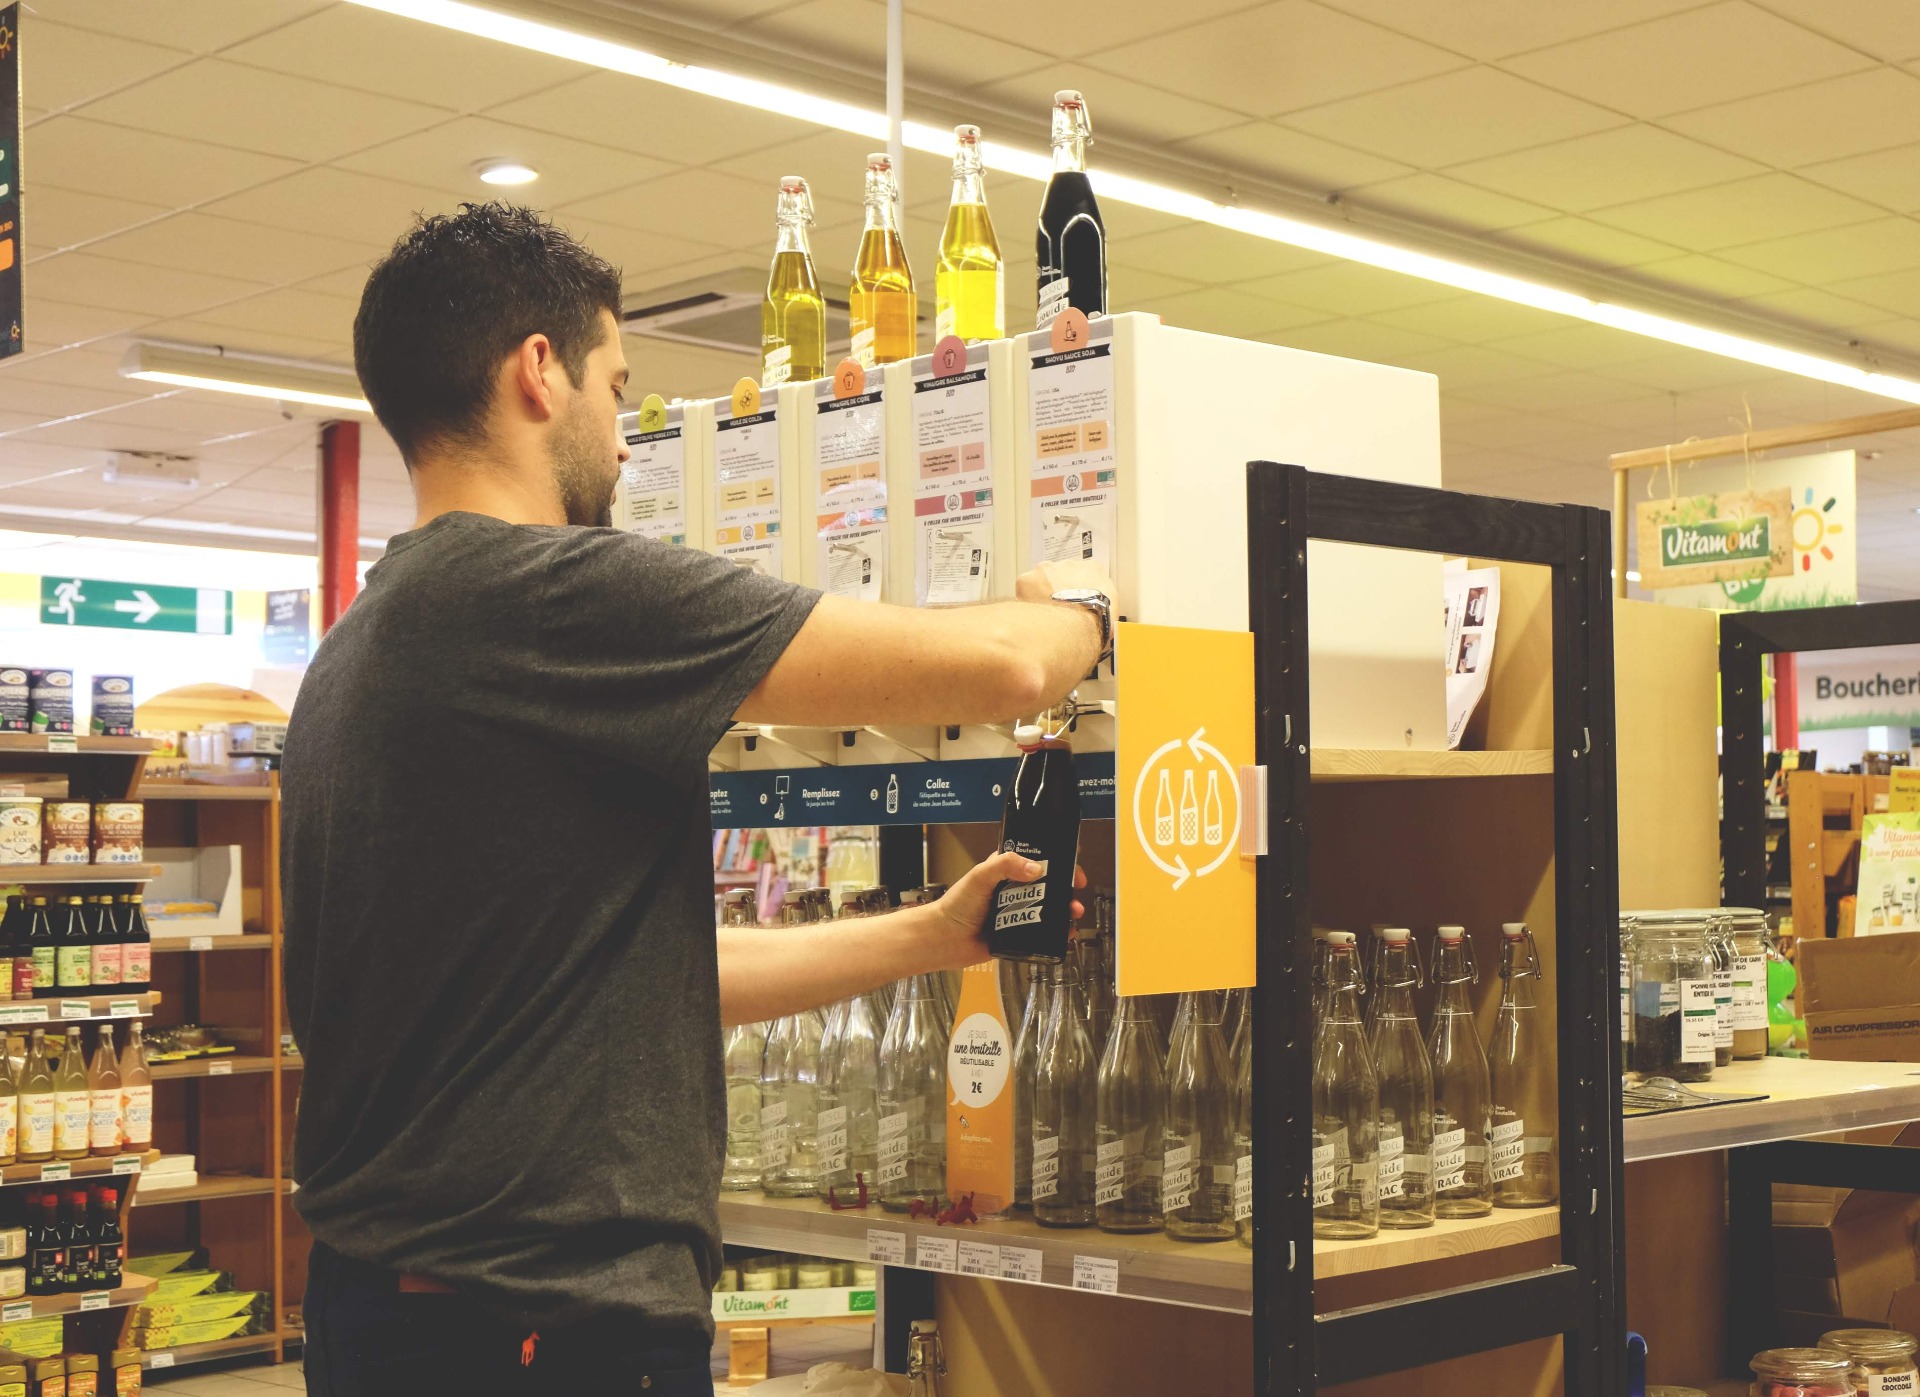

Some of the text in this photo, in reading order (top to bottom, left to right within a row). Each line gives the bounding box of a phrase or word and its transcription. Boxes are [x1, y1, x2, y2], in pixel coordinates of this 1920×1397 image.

[1064, 351, 1081, 361] SAUCE
[1081, 349, 1096, 357] SOJA
[1667, 524, 1763, 559] Vitamont
[926, 778, 950, 790] Collez
[802, 788, 840, 800] Remplissez
[1015, 846, 1042, 854] Bouteille
[1003, 910, 1036, 926] VRAC
[1813, 1026, 1832, 1034] AIR
[954, 1040, 1002, 1056] une bouteille
[960, 1058, 995, 1067] RÉUTILISABLE
[971, 1082, 982, 1094] 2€
[1502, 1126, 1511, 1136] 50
[1511, 1124, 1520, 1133] CL
[1493, 1166, 1518, 1180] VRAC
[724, 1295, 789, 1312] Vitamont
[1883, 1374, 1911, 1383] BONBONS
[1882, 1383, 1912, 1391] CROCODILE
